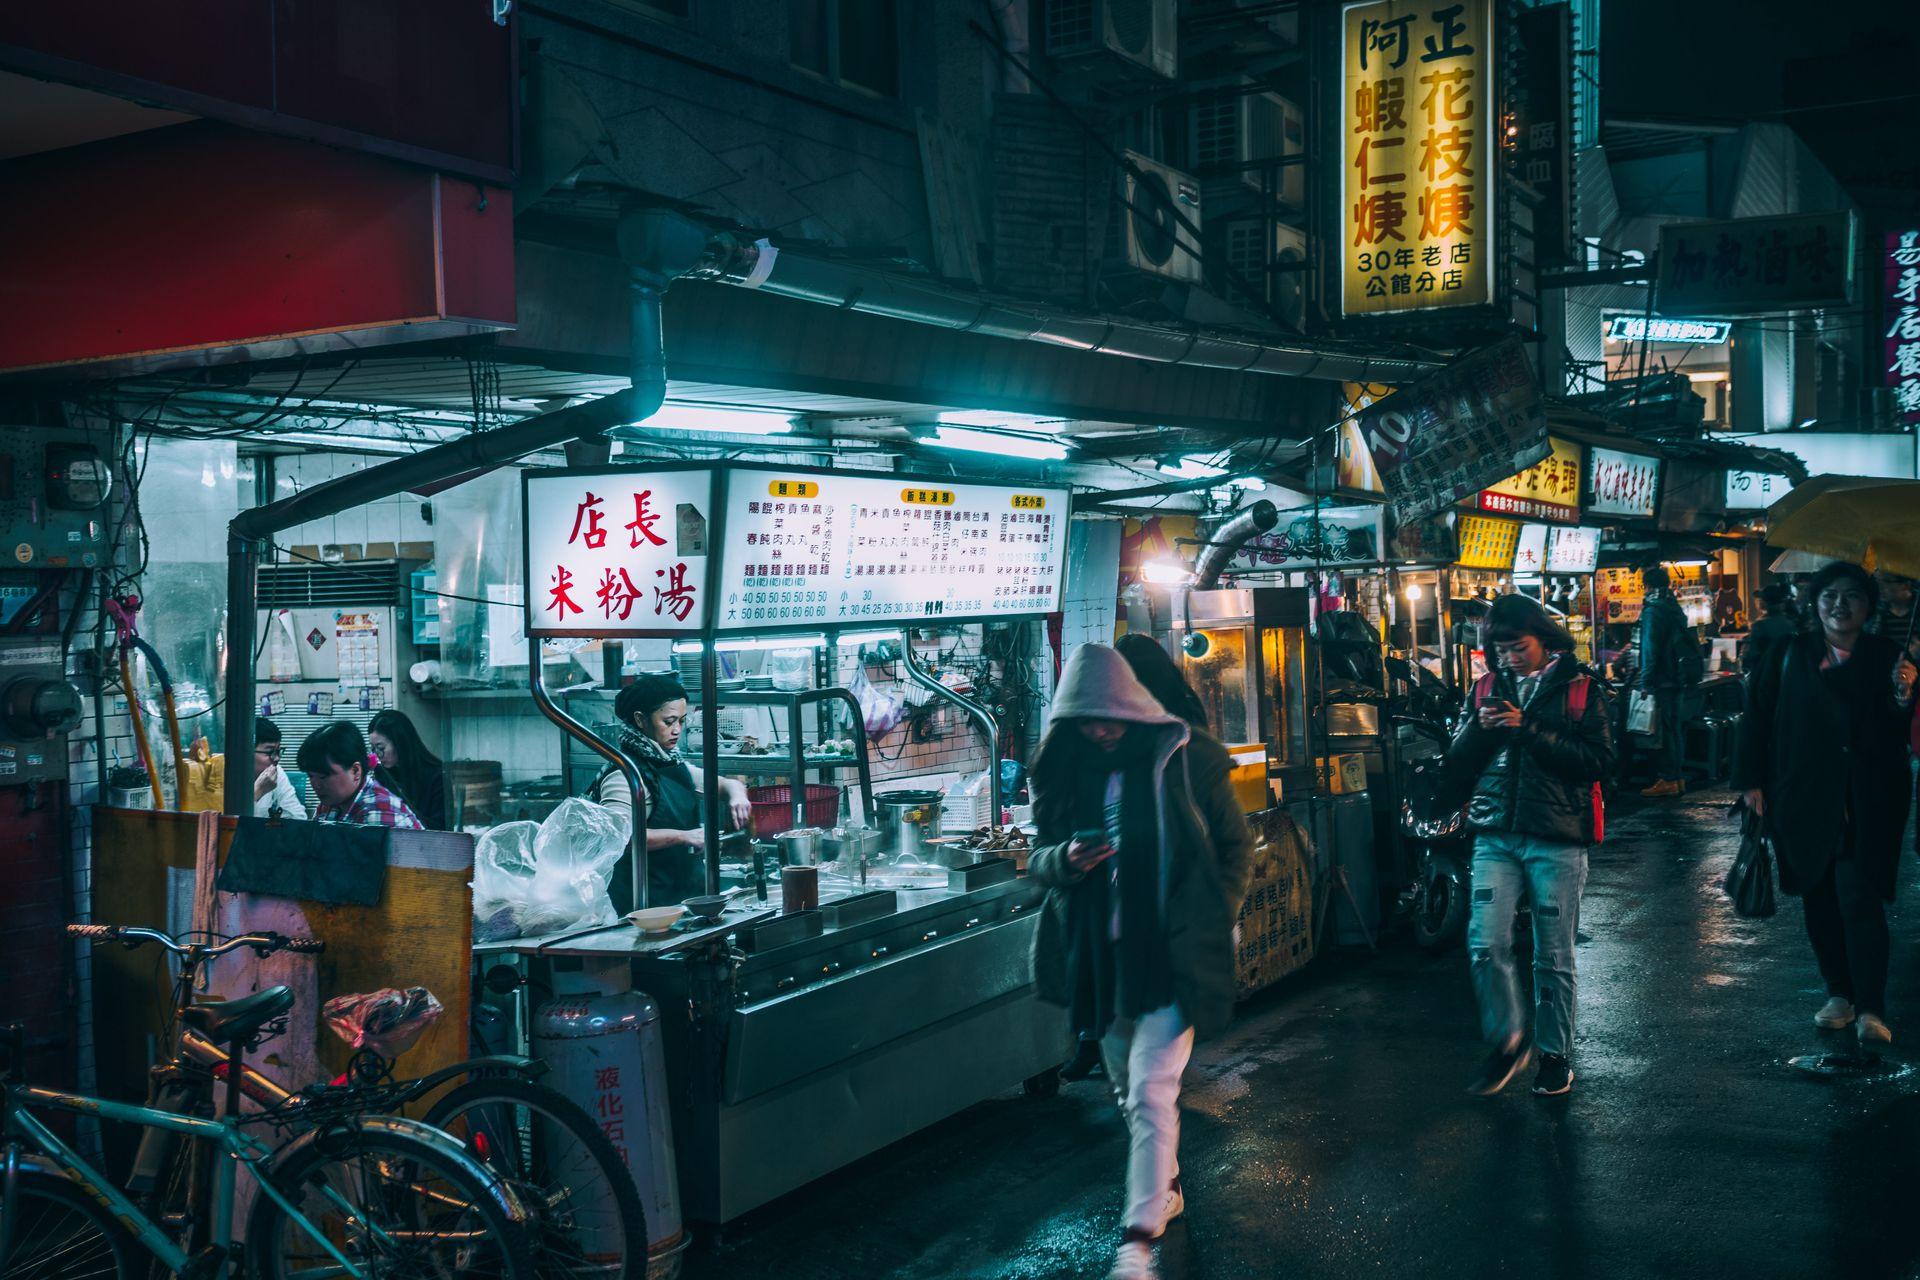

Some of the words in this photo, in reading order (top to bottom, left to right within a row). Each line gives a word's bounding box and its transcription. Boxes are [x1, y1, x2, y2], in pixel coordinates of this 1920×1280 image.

[1358, 242, 1471, 272] 30年老店
[1366, 268, 1463, 298] 公館分店
[1369, 411, 1411, 457] 10
[1513, 456, 1577, 504] 老湯頭
[1014, 496, 1042, 507] 各式小菜
[568, 489, 668, 549] 店長
[545, 562, 696, 622] 米粉湯
[729, 593, 737, 604] 小
[743, 592, 753, 604] 40
[755, 592, 766, 604] 50
[769, 592, 779, 603] 50
[781, 592, 791, 603] 50
[794, 592, 803, 603] 50
[806, 592, 815, 602] 50
[818, 591, 827, 602] 50
[841, 591, 848, 601] 小
[862, 590, 872, 600] 30
[728, 609, 736, 620] 大
[741, 608, 752, 619] 50
[754, 607, 765, 619] 60
[767, 607, 777, 618] 60
[780, 607, 790, 618] 60
[792, 606, 802, 617] 60
[804, 606, 814, 617] 60
[816, 606, 826, 617] 60
[838, 606, 847, 616] 大
